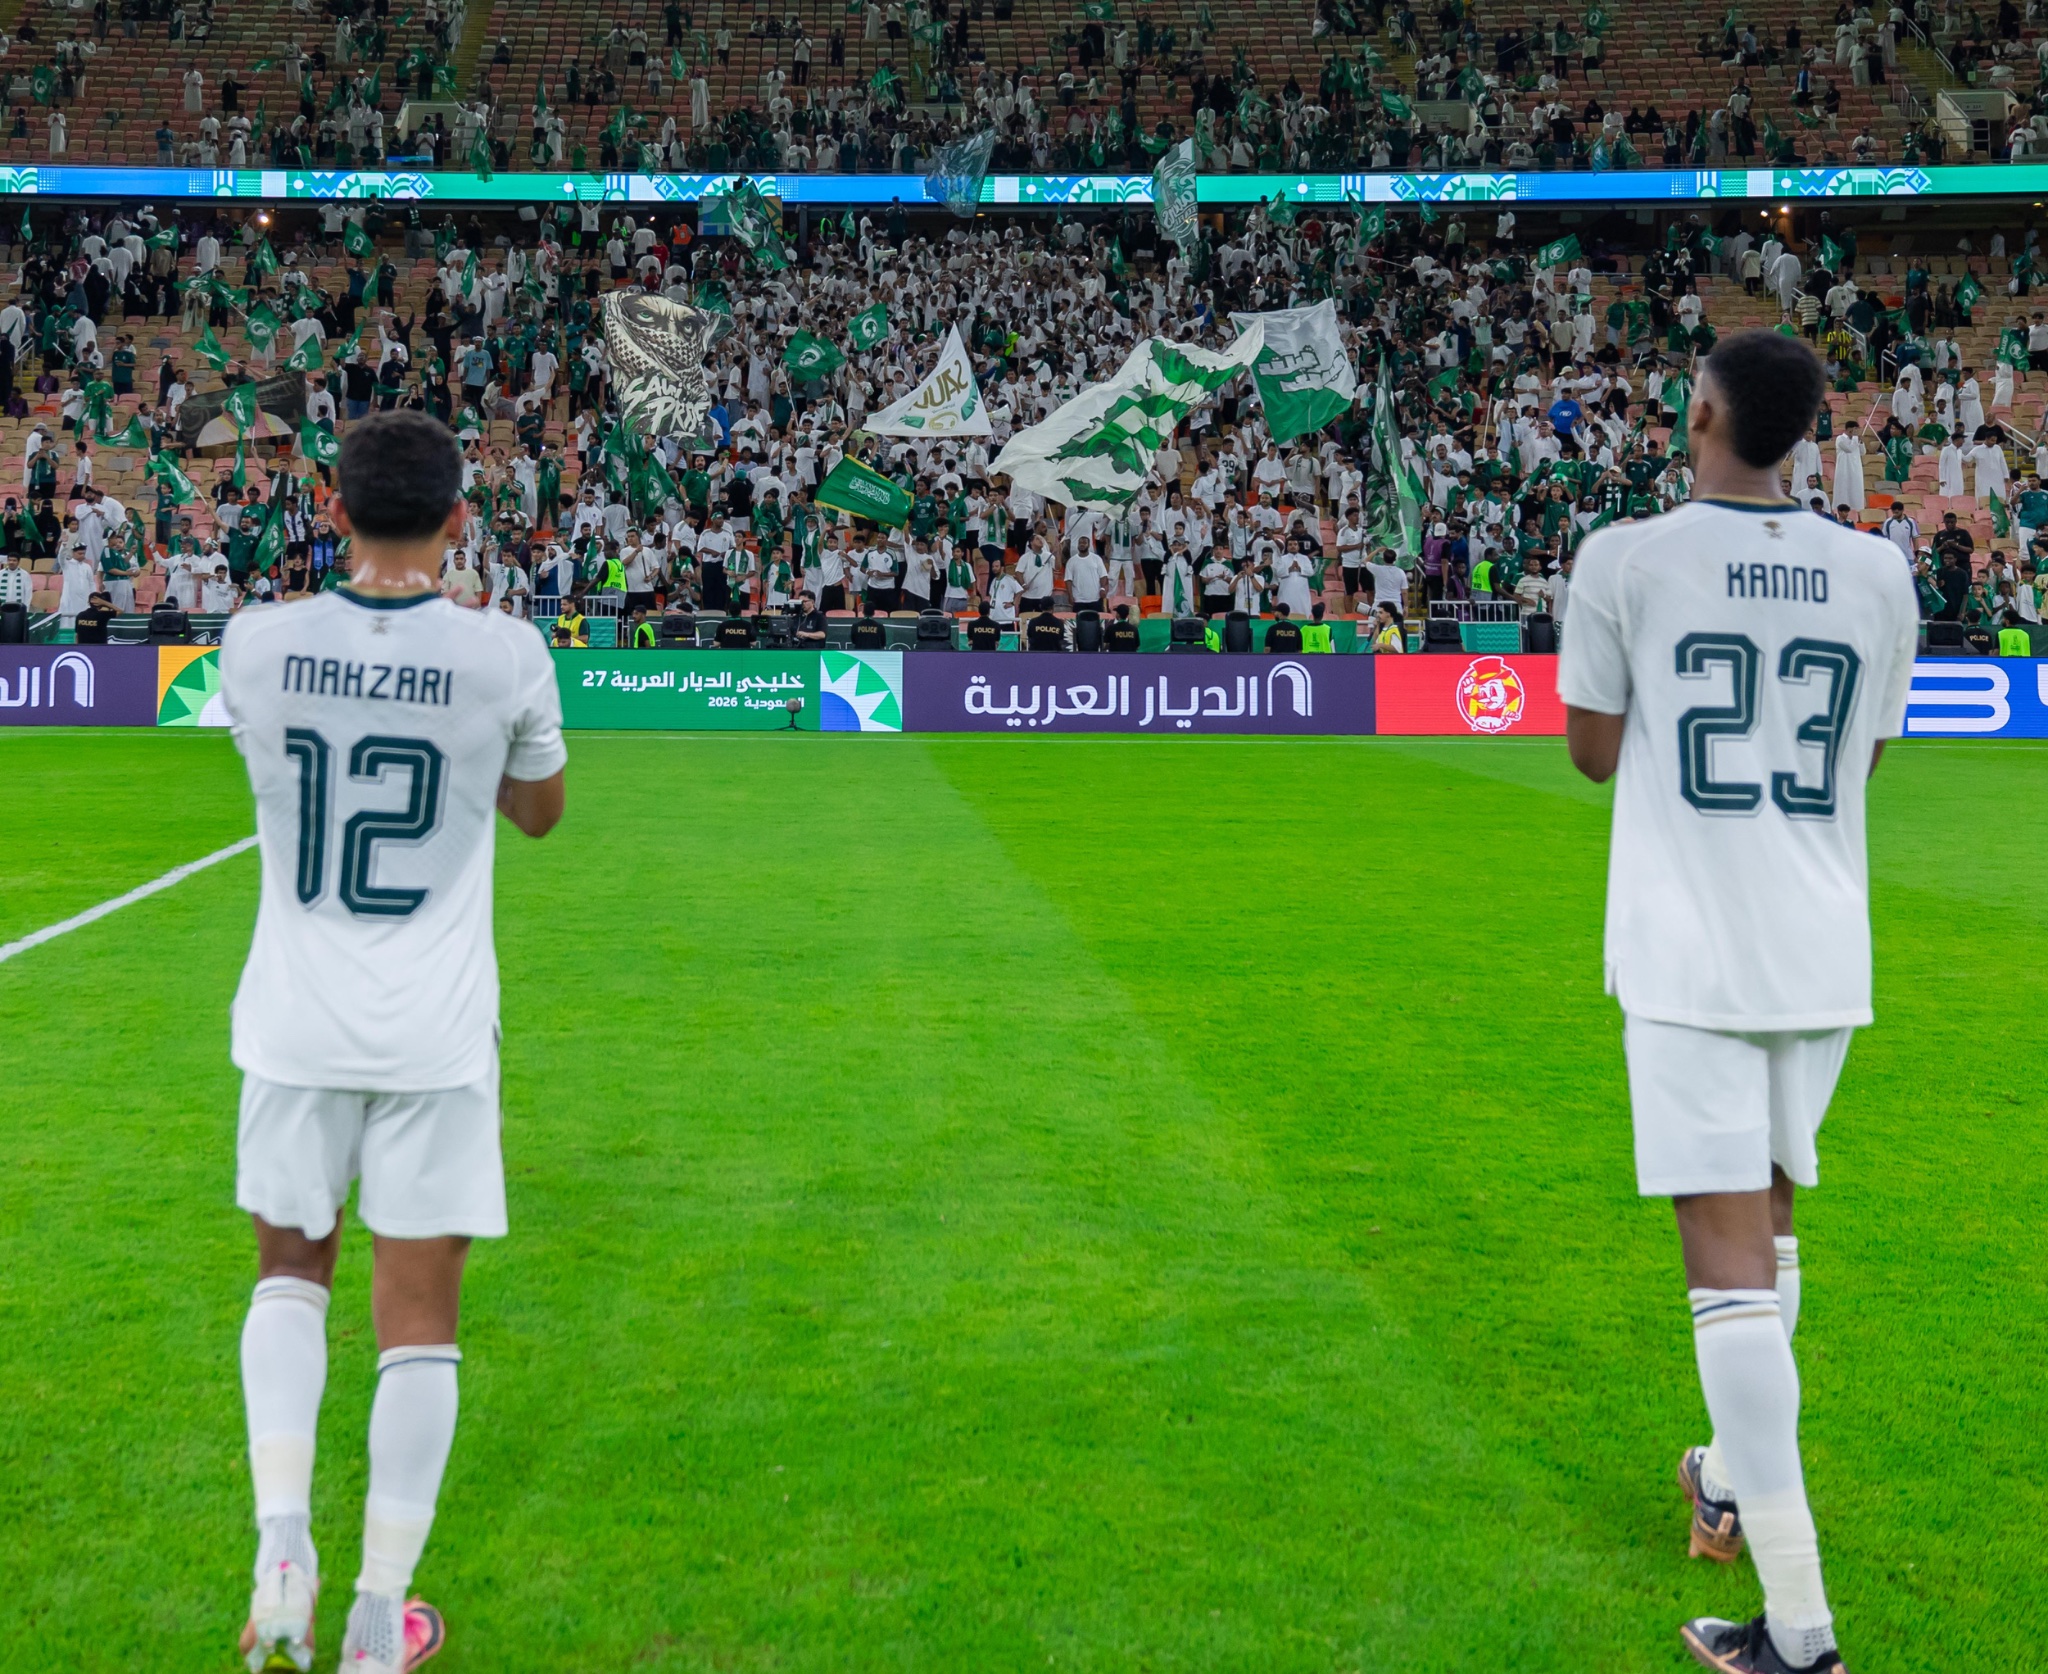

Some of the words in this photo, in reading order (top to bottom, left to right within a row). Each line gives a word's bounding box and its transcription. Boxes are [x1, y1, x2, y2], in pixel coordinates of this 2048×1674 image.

[1726, 562, 1829, 604] KANNO
[78, 619, 98, 627] POLICE
[725, 628, 747, 636] POLICE
[857, 626, 878, 634] POLICE
[974, 627, 996, 635] POLICE
[1035, 625, 1060, 635] POLICE
[1115, 631, 1135, 639] POLICE
[1276, 629, 1296, 637] POLICE
[282, 654, 454, 706] MAHZARI
[582, 670, 608, 687] 27
[610, 670, 675, 692] العربية
[678, 671, 732, 692] الديار
[736, 672, 805, 693] خليجي
[708, 696, 738, 708] 2026
[964, 675, 1130, 727] العربية
[1139, 676, 1258, 729] الديار
[1674, 632, 1865, 822] 23
[284, 727, 451, 924] 12
